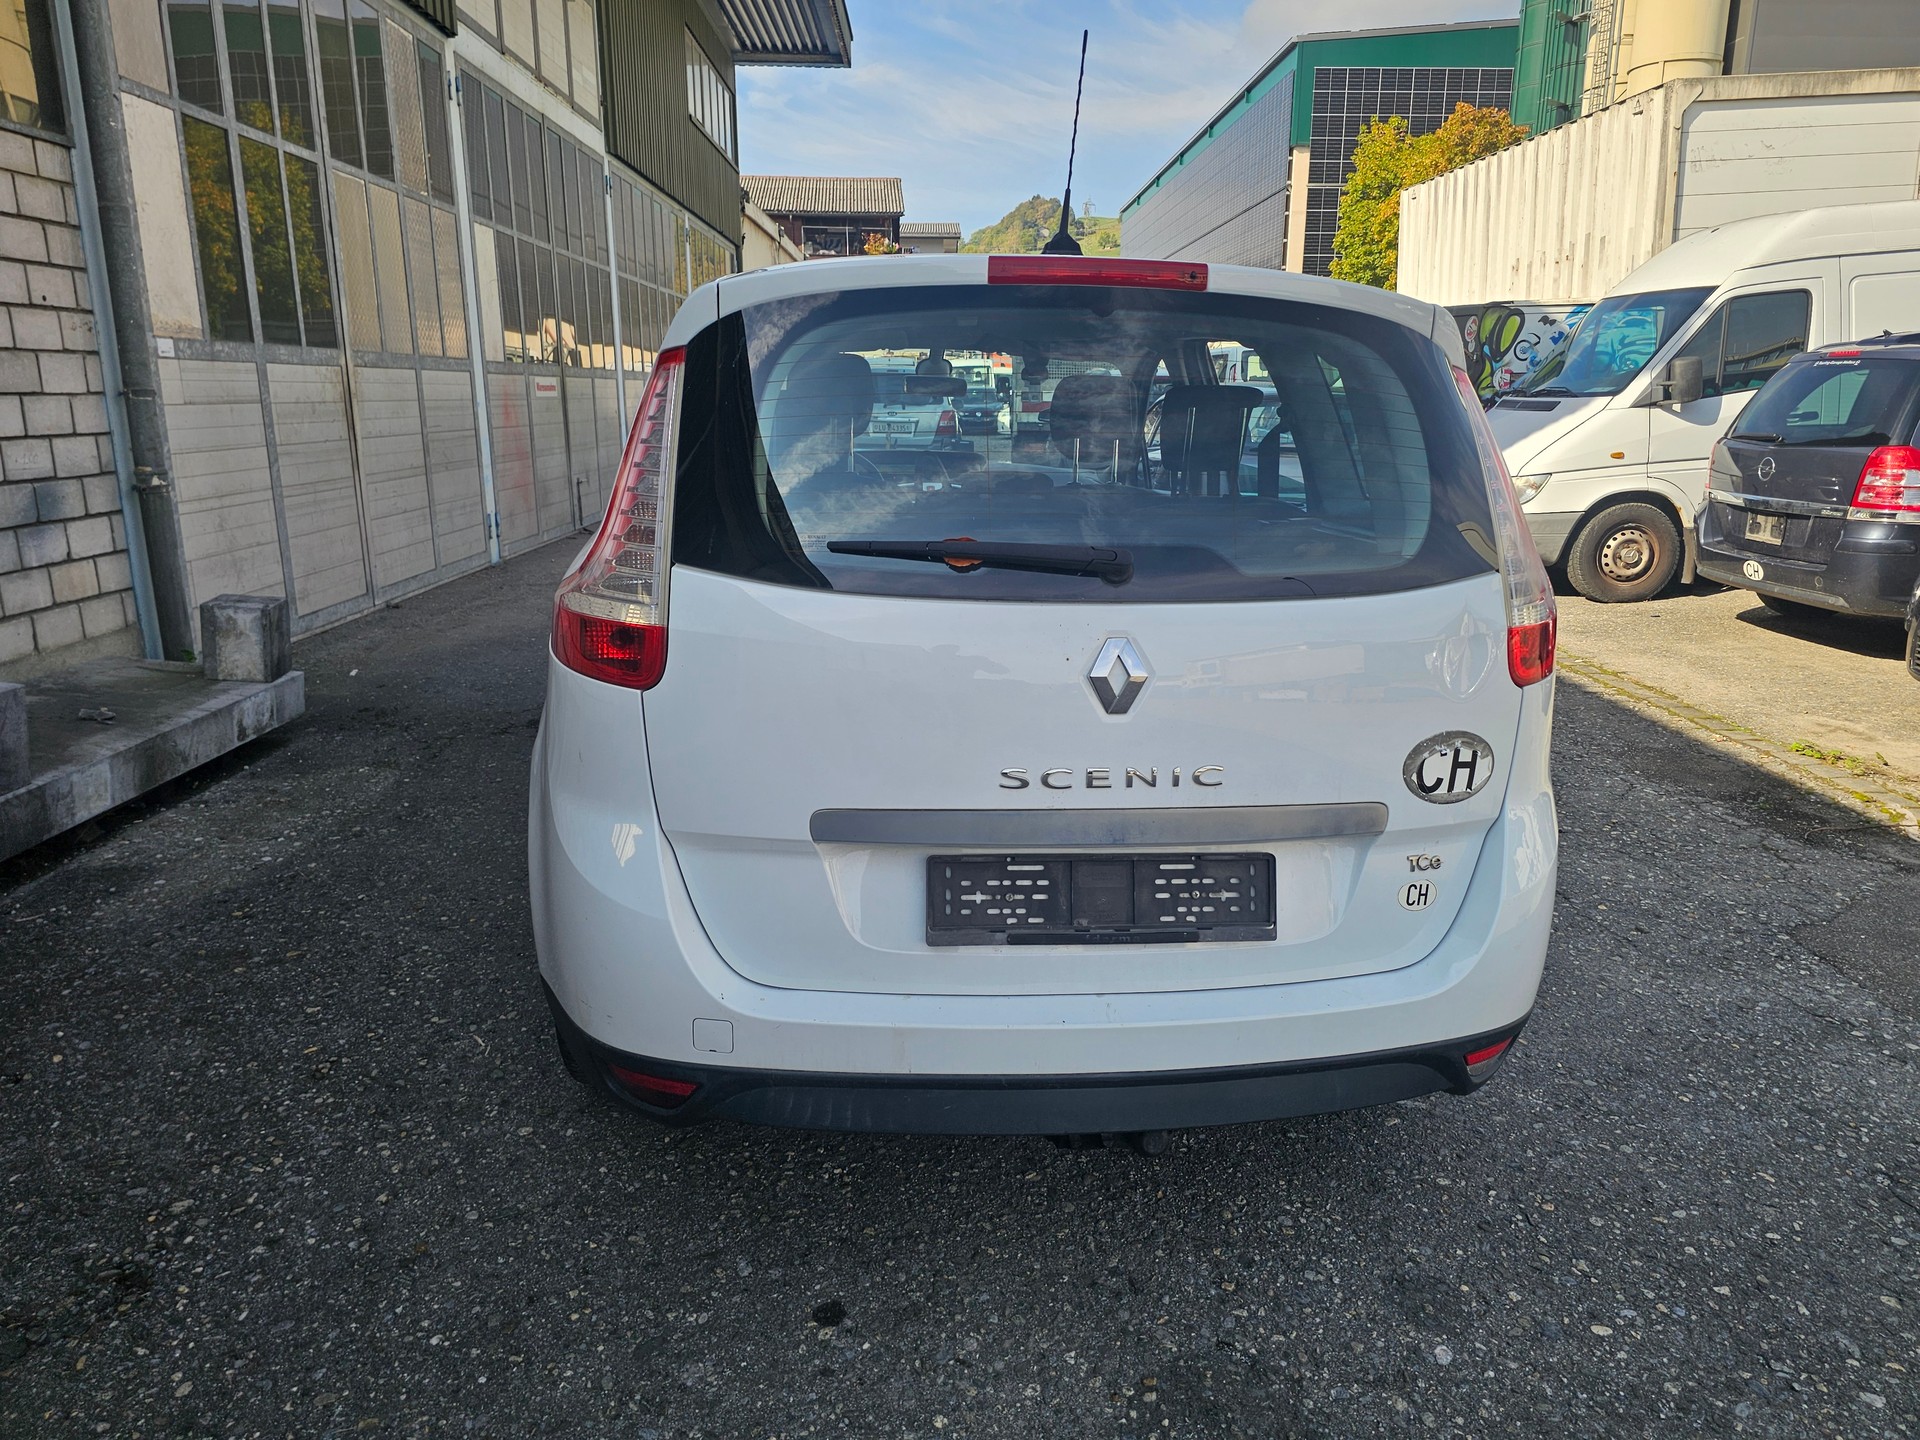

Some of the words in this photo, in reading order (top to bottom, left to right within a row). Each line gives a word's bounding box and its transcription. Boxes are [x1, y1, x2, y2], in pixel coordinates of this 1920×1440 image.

[1746, 562, 1760, 579] CH
[999, 764, 1224, 790] SCENIC
[1415, 747, 1479, 795] CH
[1406, 854, 1444, 873] TCe
[1405, 883, 1430, 907] CH
